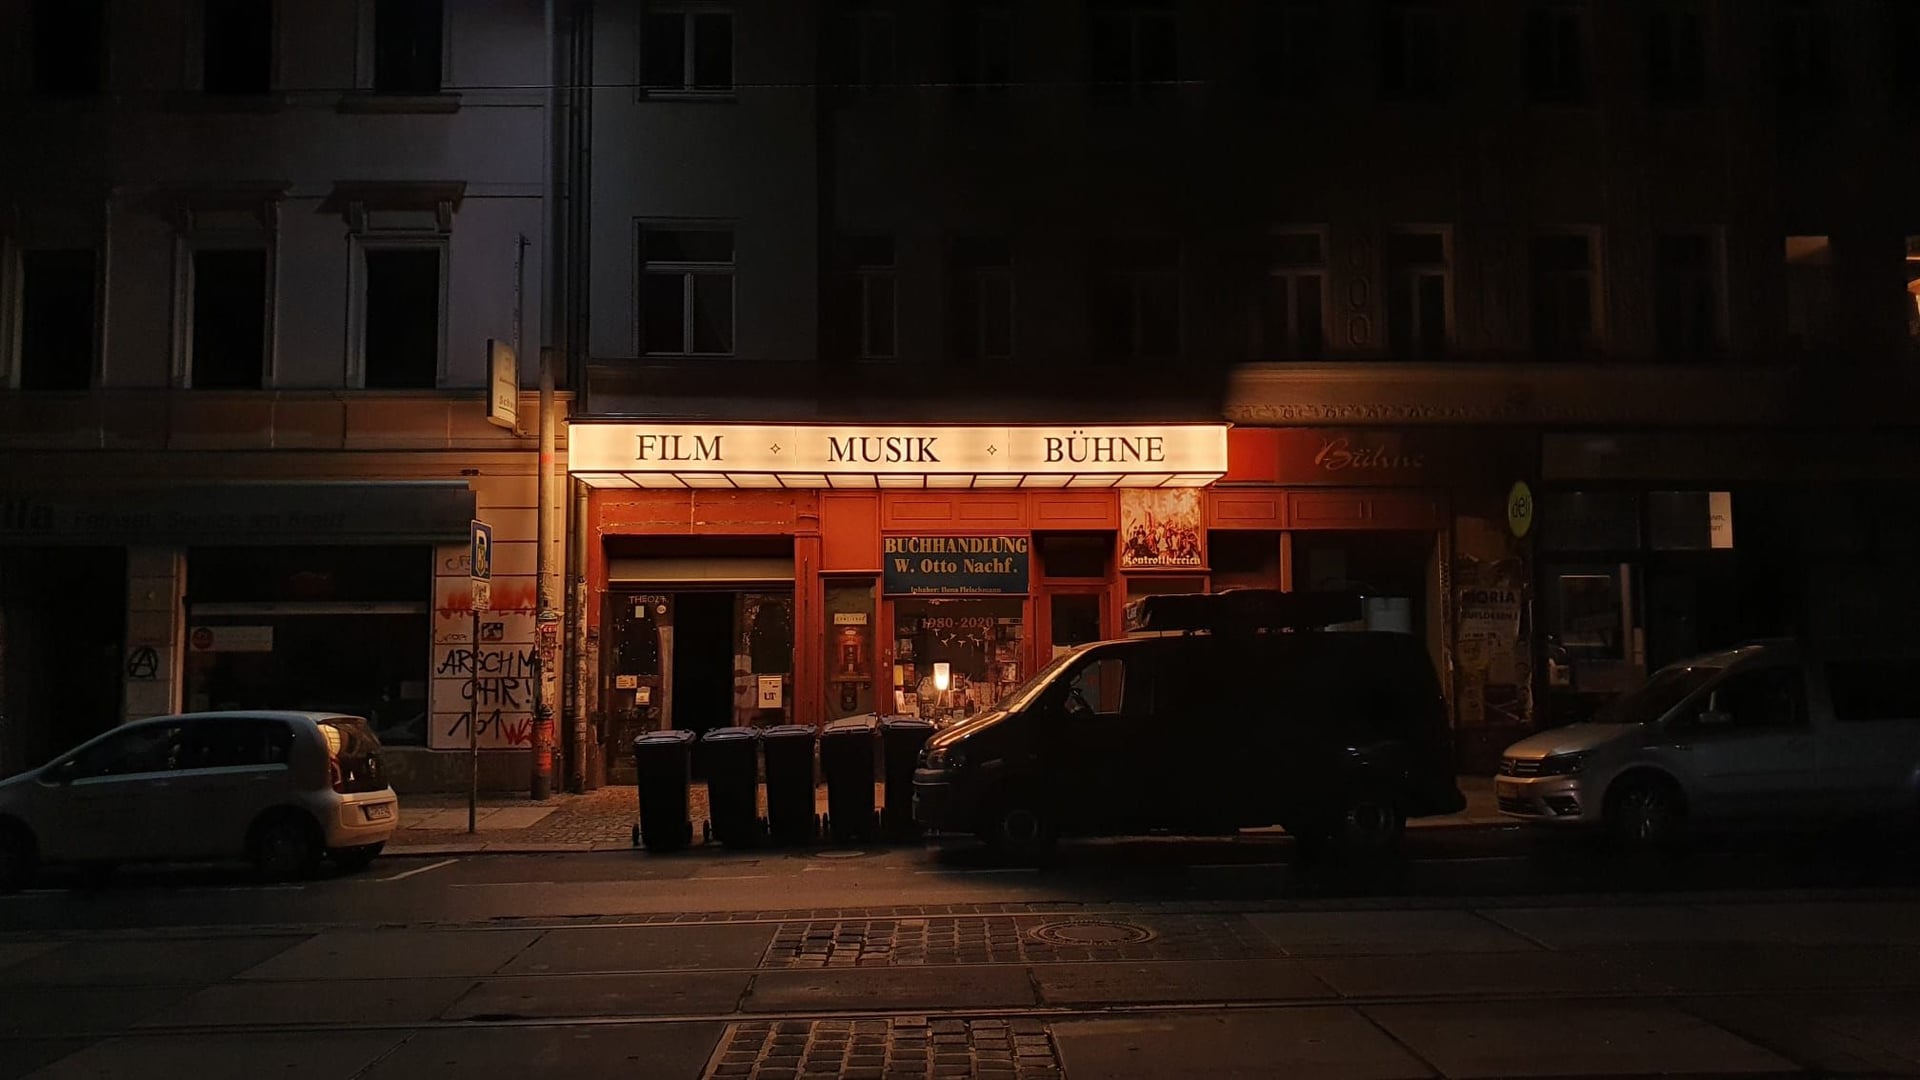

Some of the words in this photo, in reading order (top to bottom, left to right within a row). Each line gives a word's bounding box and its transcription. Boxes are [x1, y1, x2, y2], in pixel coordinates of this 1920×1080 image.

[635, 434, 724, 462] FILM
[827, 435, 941, 463] MUSIK
[1043, 429, 1166, 463] BÜHNE
[1314, 437, 1425, 472] Bühne
[884, 536, 1028, 554] BUCHHANDLUNG
[894, 558, 915, 574] W.
[920, 557, 958, 574] Otto
[963, 556, 1018, 574] Nachf.
[920, 617, 995, 629] 1980-2020
